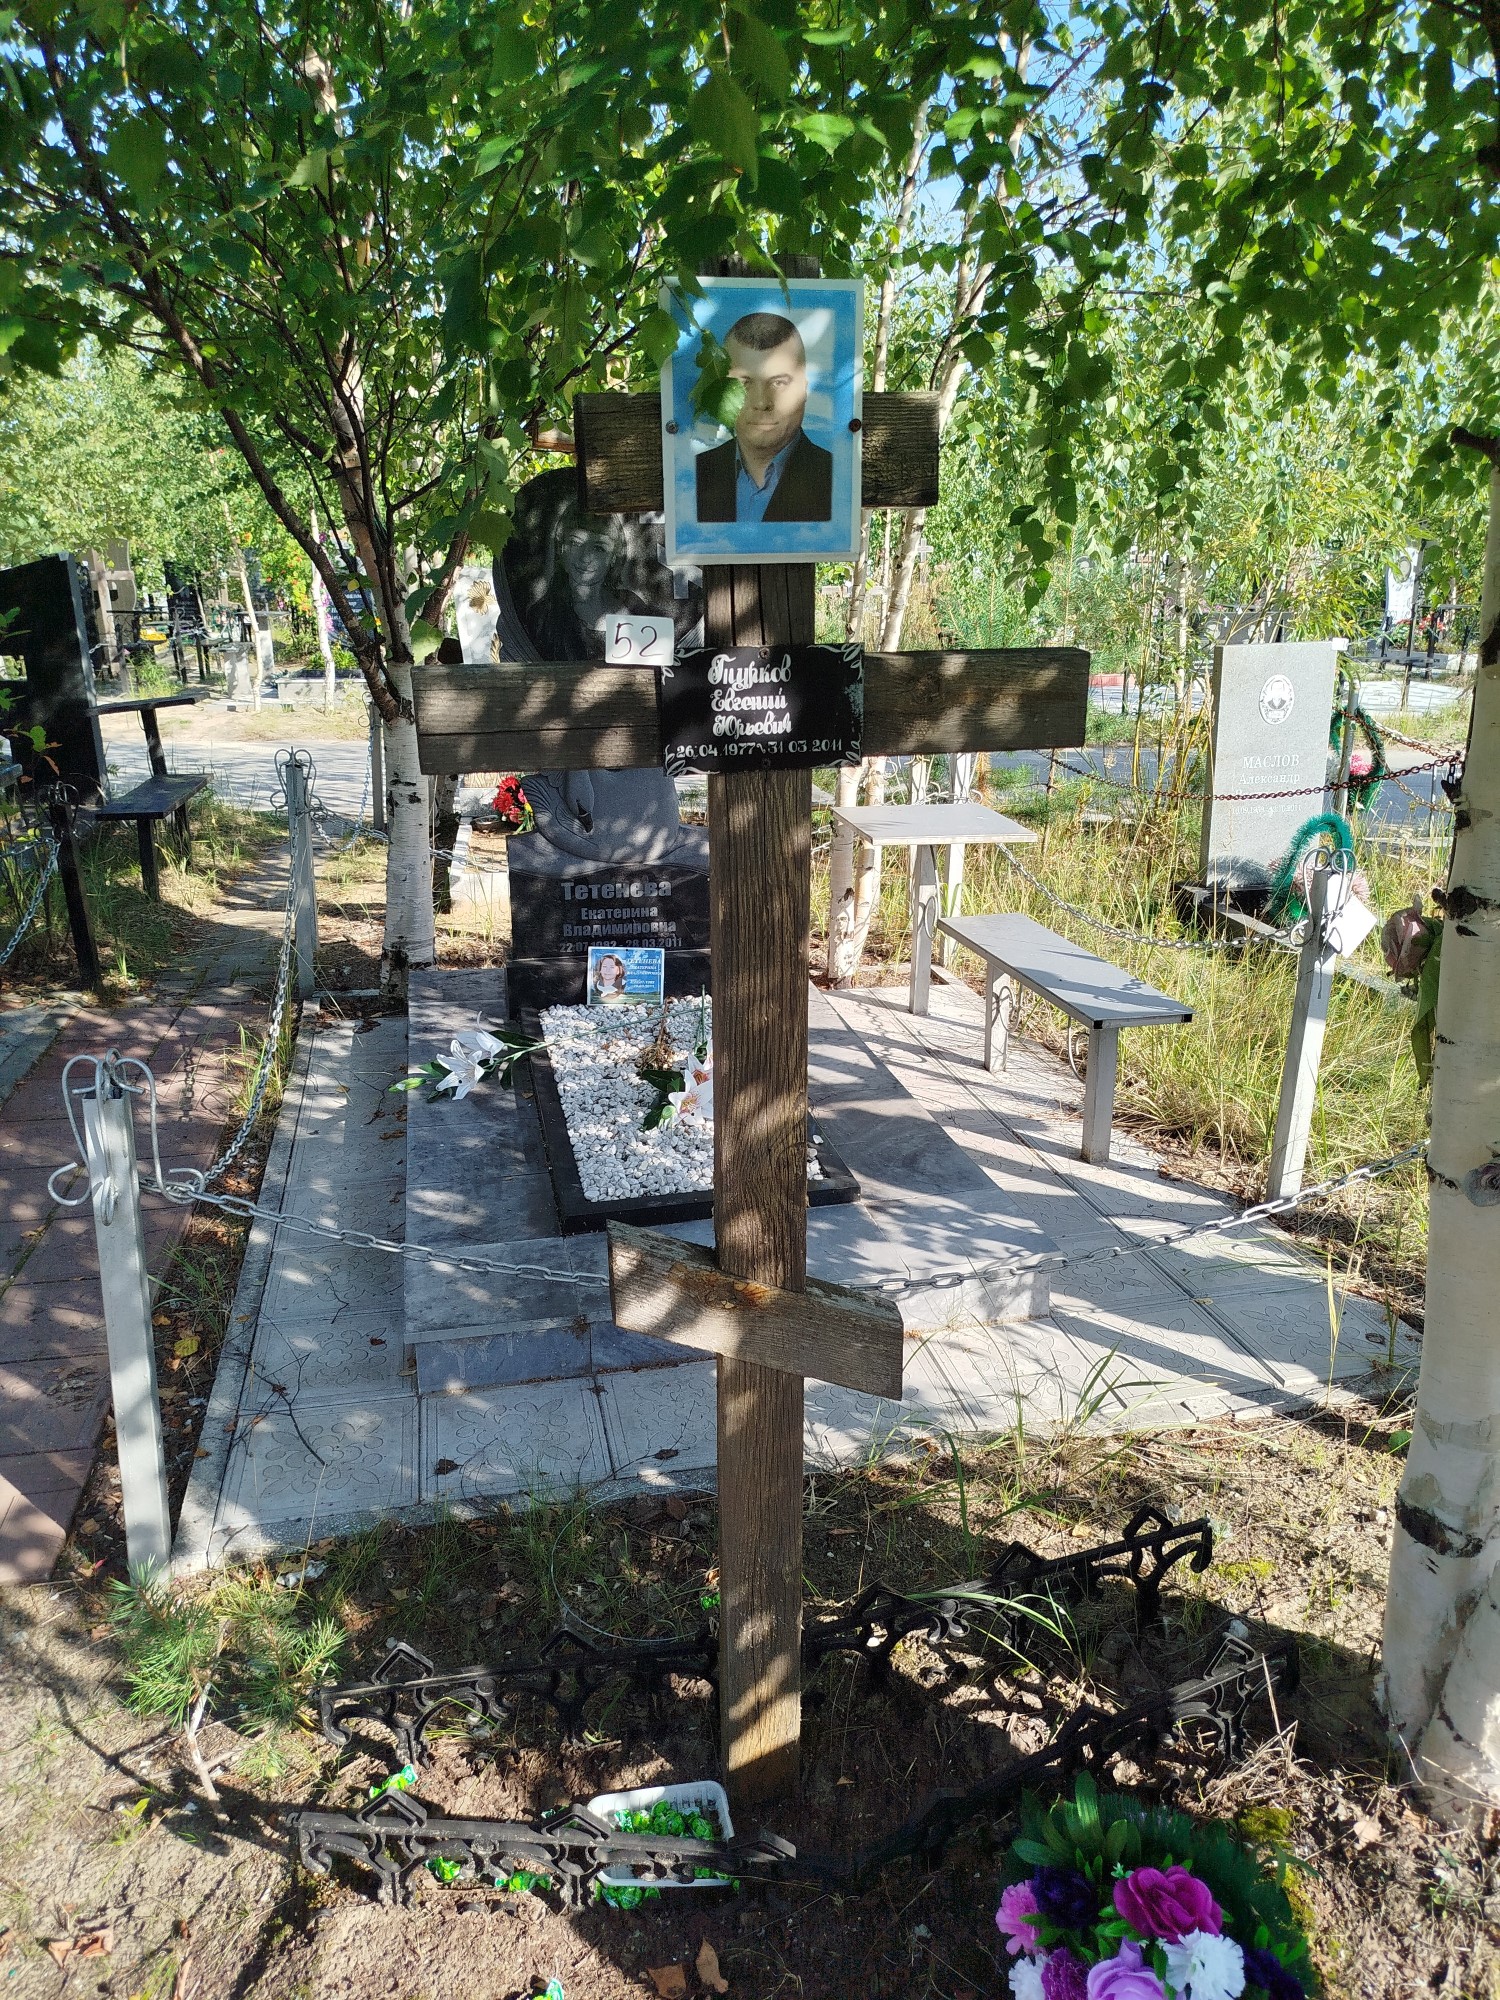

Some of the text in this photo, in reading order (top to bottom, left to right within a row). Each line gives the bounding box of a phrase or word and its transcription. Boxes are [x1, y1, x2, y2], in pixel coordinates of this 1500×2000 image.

[611, 622, 664, 658] 52
[710, 687, 788, 712] Евгений
[712, 710, 792, 740] Юрьевич
[1243, 754, 1300, 769] МАСЛОВ
[1238, 772, 1300, 785] Александр
[560, 881, 672, 900] Тетенева
[581, 907, 658, 920] Екатерина
[563, 921, 677, 939] Владимировна
